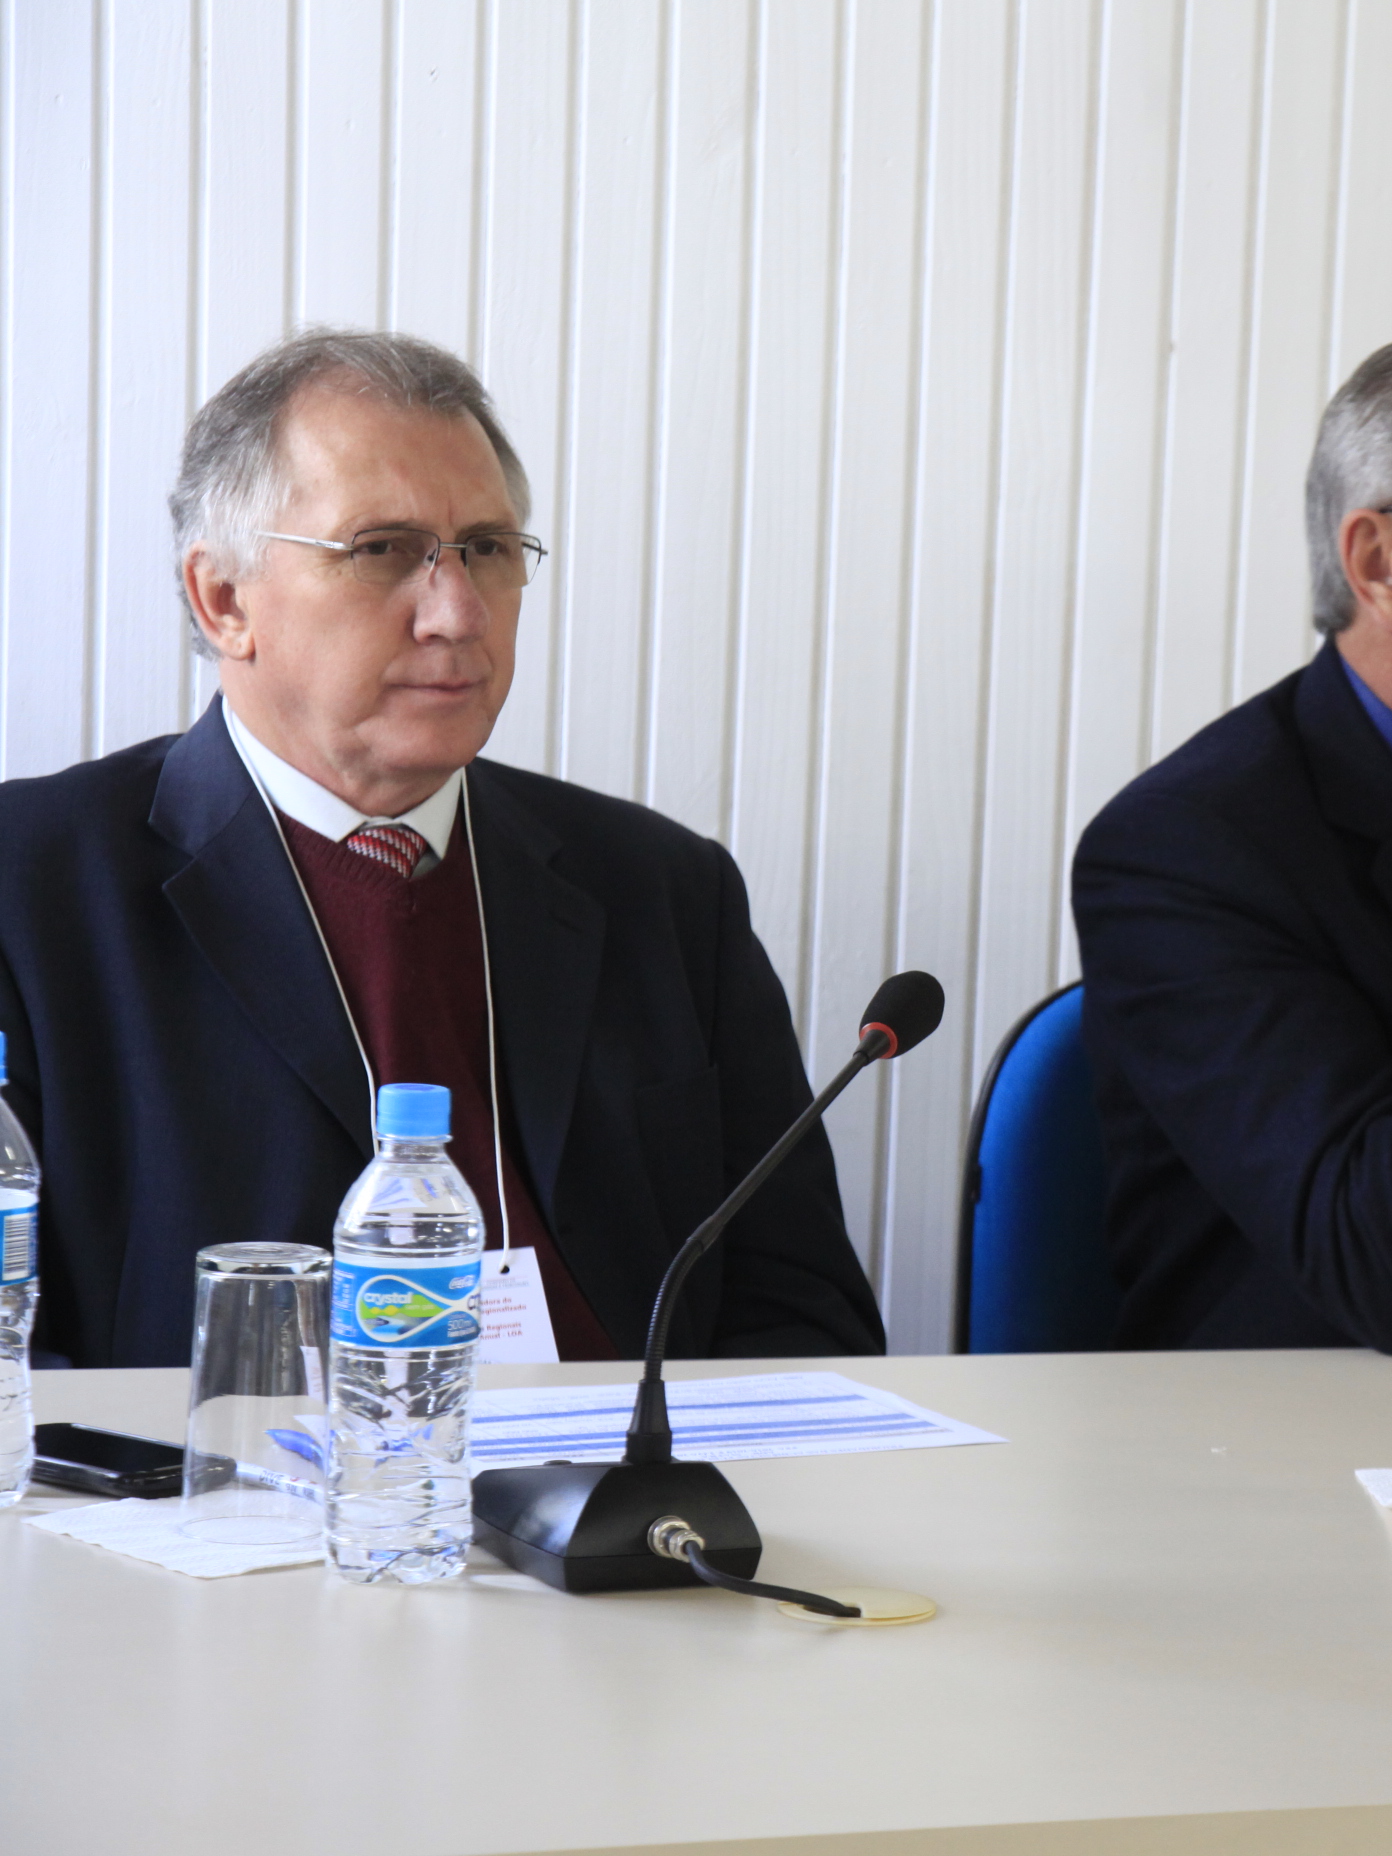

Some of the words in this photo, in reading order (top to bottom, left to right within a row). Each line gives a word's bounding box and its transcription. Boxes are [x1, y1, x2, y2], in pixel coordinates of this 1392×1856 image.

[363, 1291, 413, 1306] crystal
[486, 1321, 522, 1331] Regionais
[507, 1330, 522, 1338] LOA
